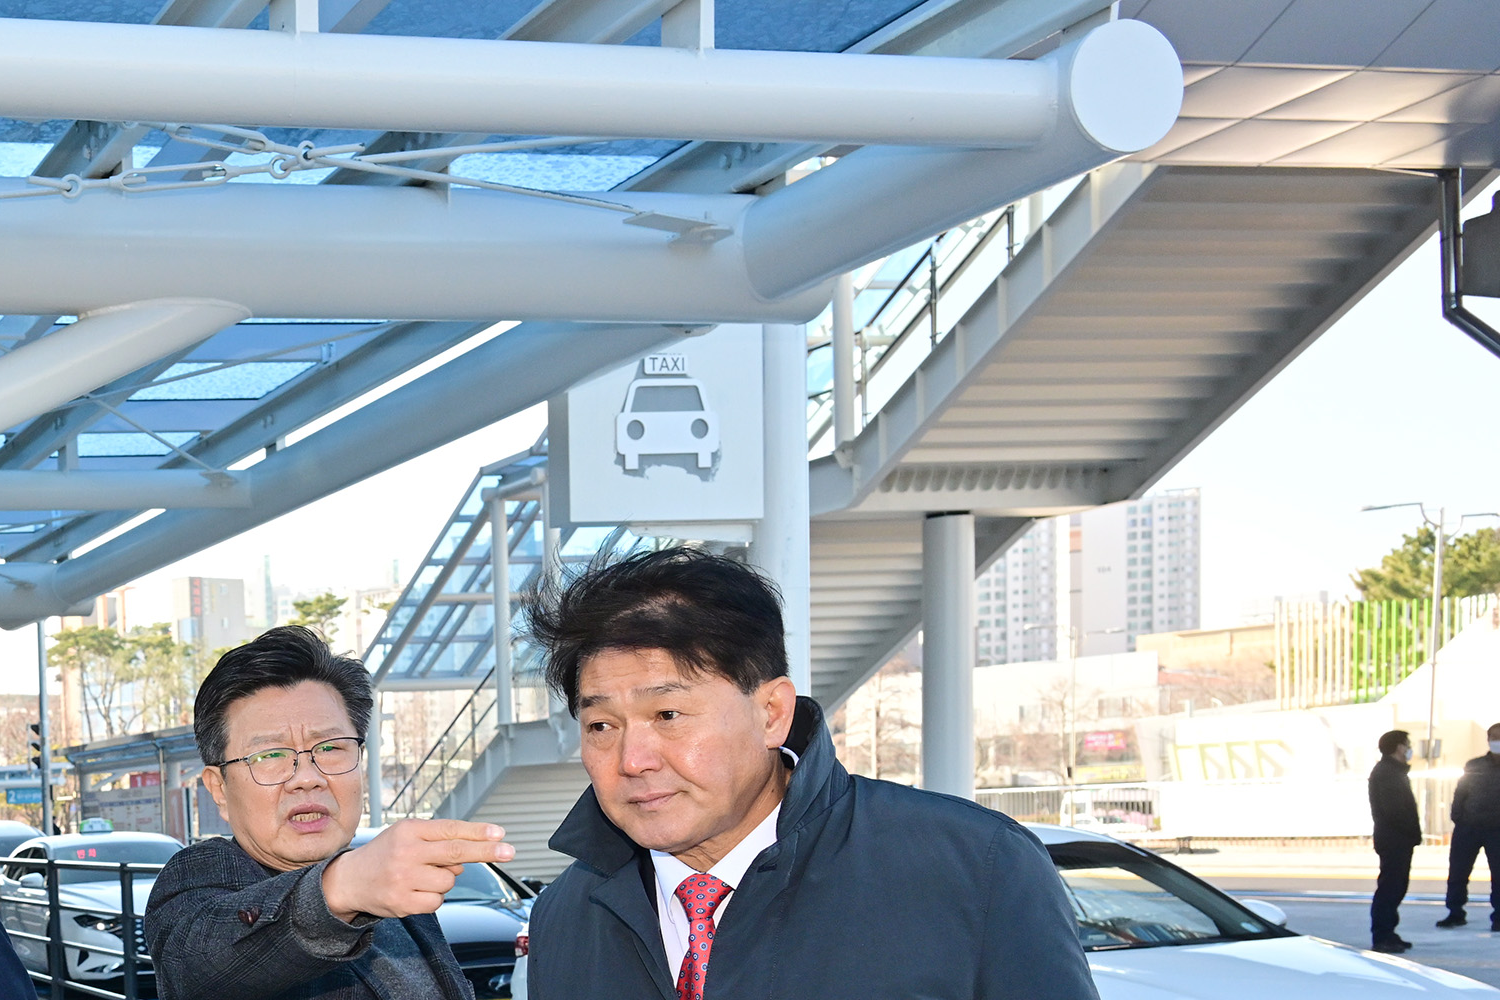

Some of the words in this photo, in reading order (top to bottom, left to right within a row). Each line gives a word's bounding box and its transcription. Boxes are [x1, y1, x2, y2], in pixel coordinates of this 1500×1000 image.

[649, 356, 685, 371] TAXI
[135, 776, 142, 787] 1
[8, 790, 16, 802] 2
